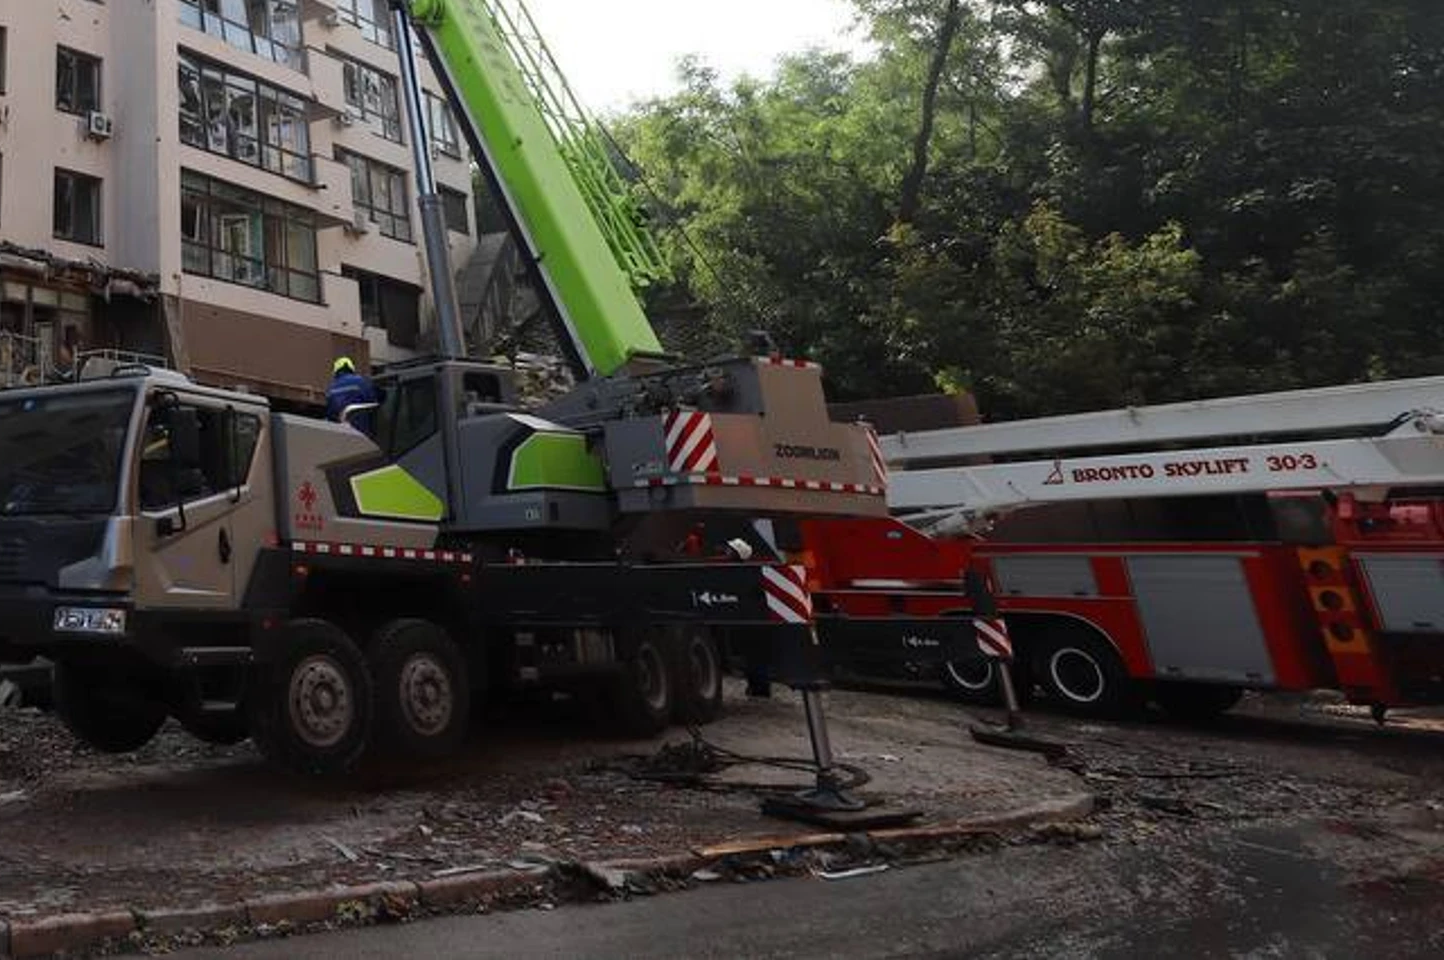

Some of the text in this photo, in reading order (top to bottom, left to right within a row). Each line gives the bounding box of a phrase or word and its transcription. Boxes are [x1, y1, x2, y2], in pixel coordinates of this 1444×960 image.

[774, 443, 840, 461] ZOOMLION
[1072, 464, 1154, 483] BRONTO
[1163, 458, 1250, 478] SKYLIFT
